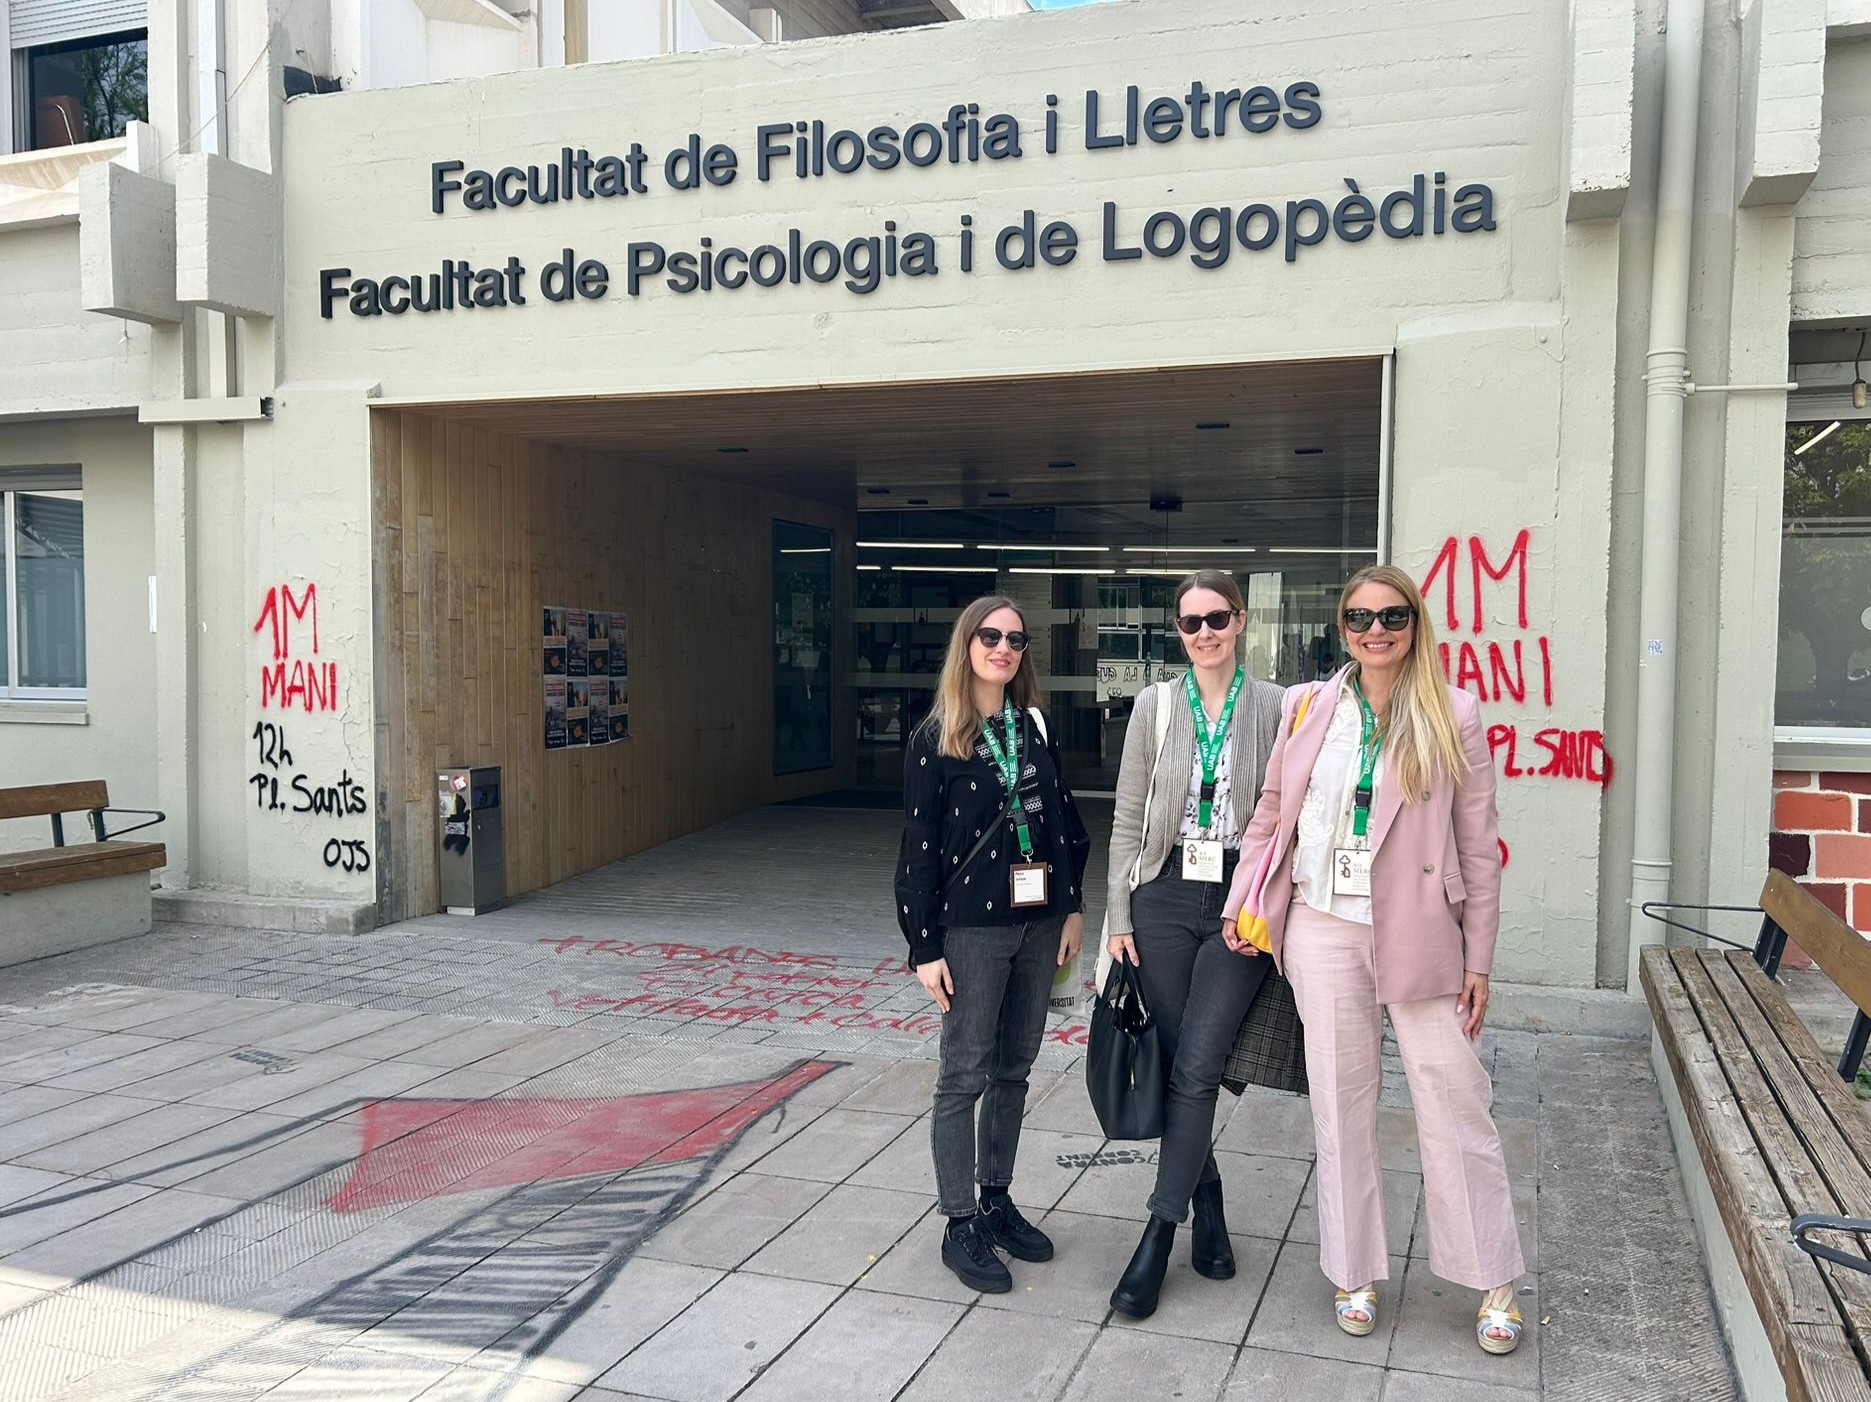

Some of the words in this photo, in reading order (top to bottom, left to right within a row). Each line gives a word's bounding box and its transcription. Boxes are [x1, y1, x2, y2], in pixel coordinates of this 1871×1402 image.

[431, 142, 648, 214] Facultat
[664, 133, 739, 191] de
[756, 102, 1022, 182] Filosofia
[1045, 94, 1058, 154] i
[1085, 80, 1322, 151] Lletres
[319, 256, 526, 319] Facultat
[540, 248, 609, 302] de
[627, 220, 938, 296] Psicologia
[961, 214, 972, 272] i
[995, 210, 1078, 270] de
[1102, 171, 1496, 270] Logopèdia
[1420, 529, 1529, 636] 1M
[253, 583, 319, 660] 1M
[261, 659, 337, 714] MANI
[983, 728, 997, 747] UAB
[1004, 708, 1014, 724] UAB
[1193, 706, 1203, 724] UAB
[252, 721, 294, 770] 12h
[249, 773, 286, 813] Pl.
[291, 769, 367, 818] Sants
[323, 838, 371, 872] OJS
